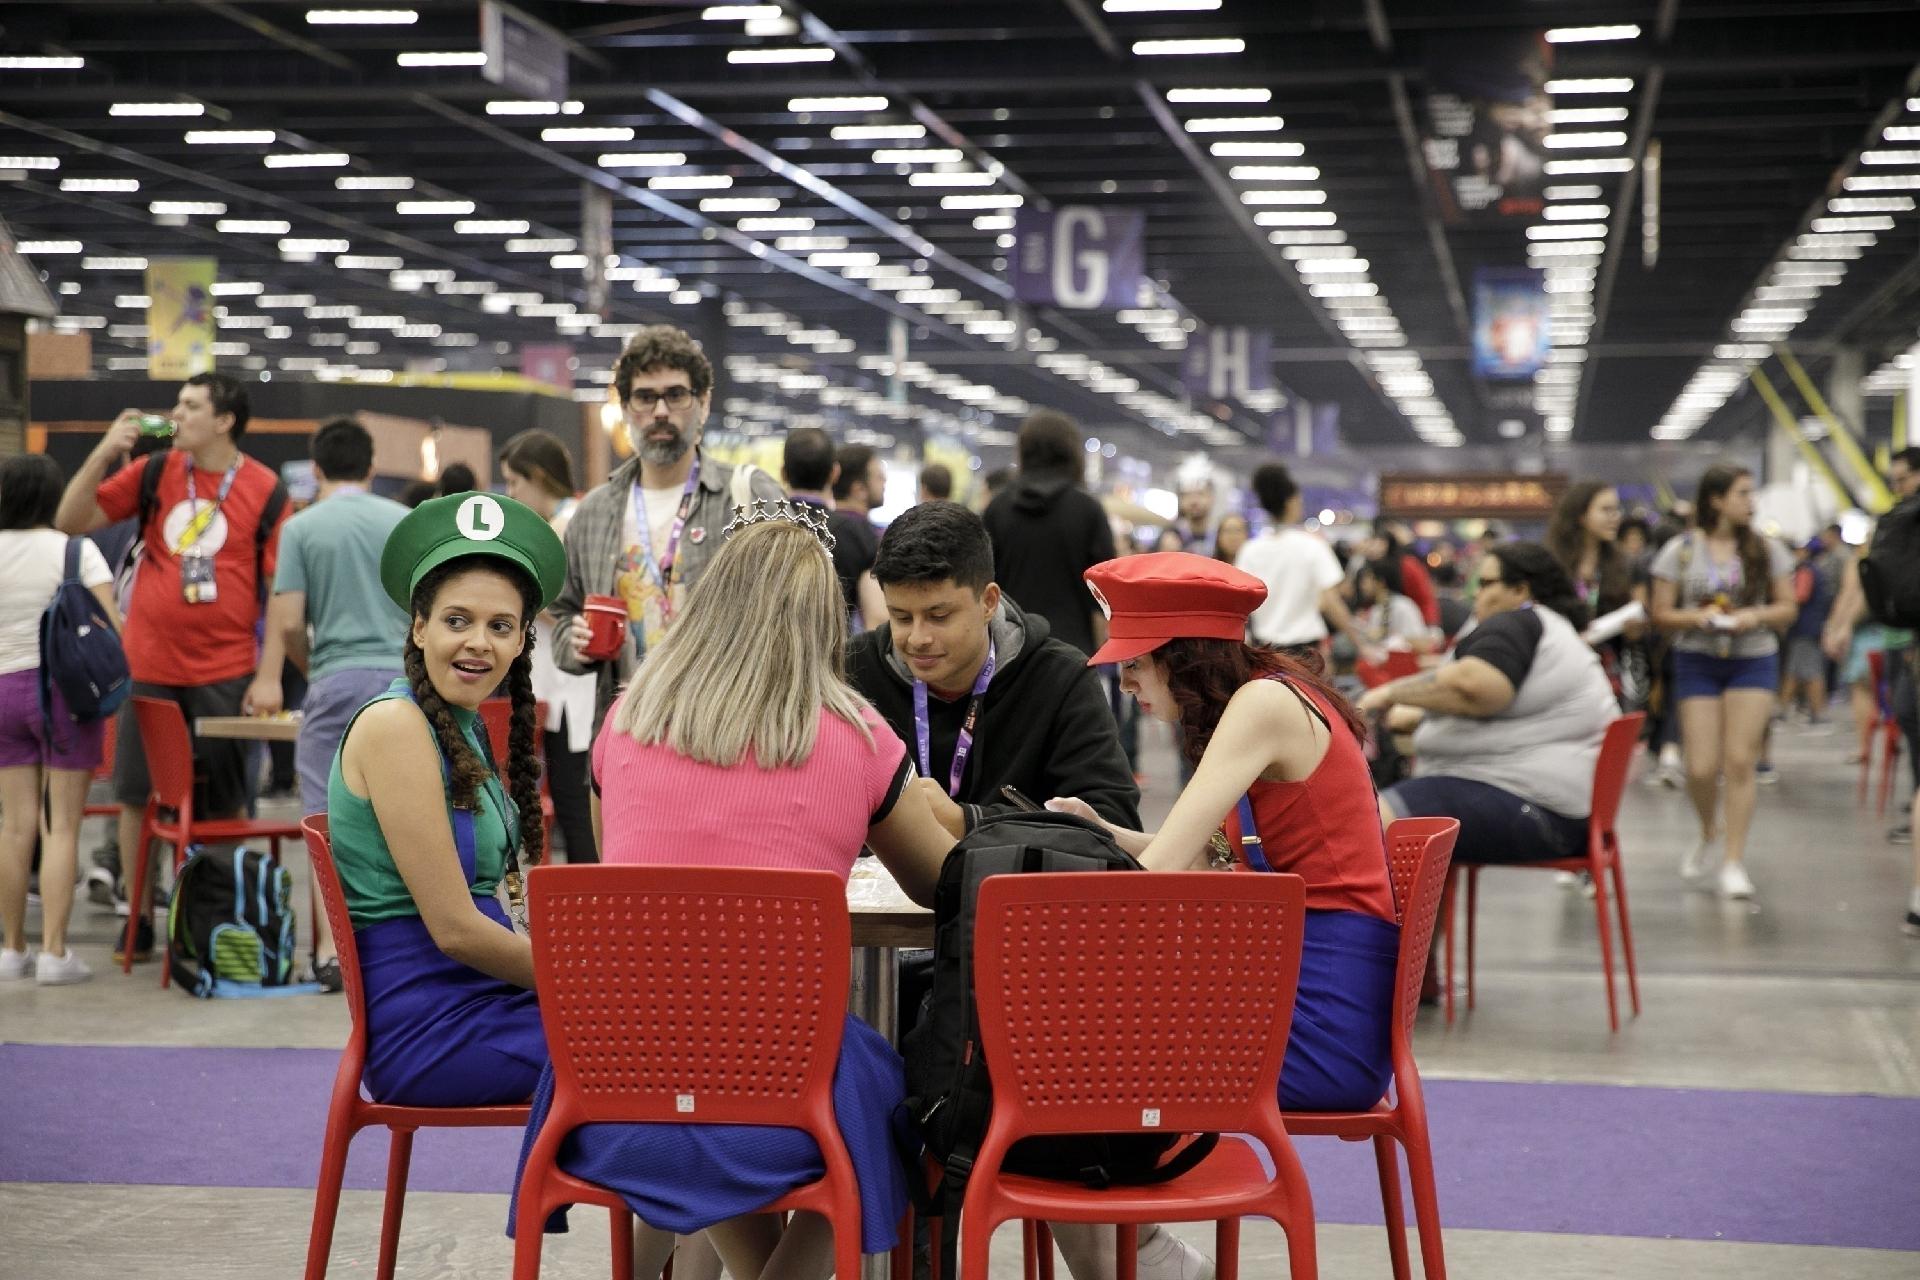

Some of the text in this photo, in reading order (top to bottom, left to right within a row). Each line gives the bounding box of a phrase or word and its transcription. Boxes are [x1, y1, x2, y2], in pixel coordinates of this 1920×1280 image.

[1053, 205, 1108, 308] G
[1210, 327, 1249, 399] H
[473, 503, 490, 531] L
